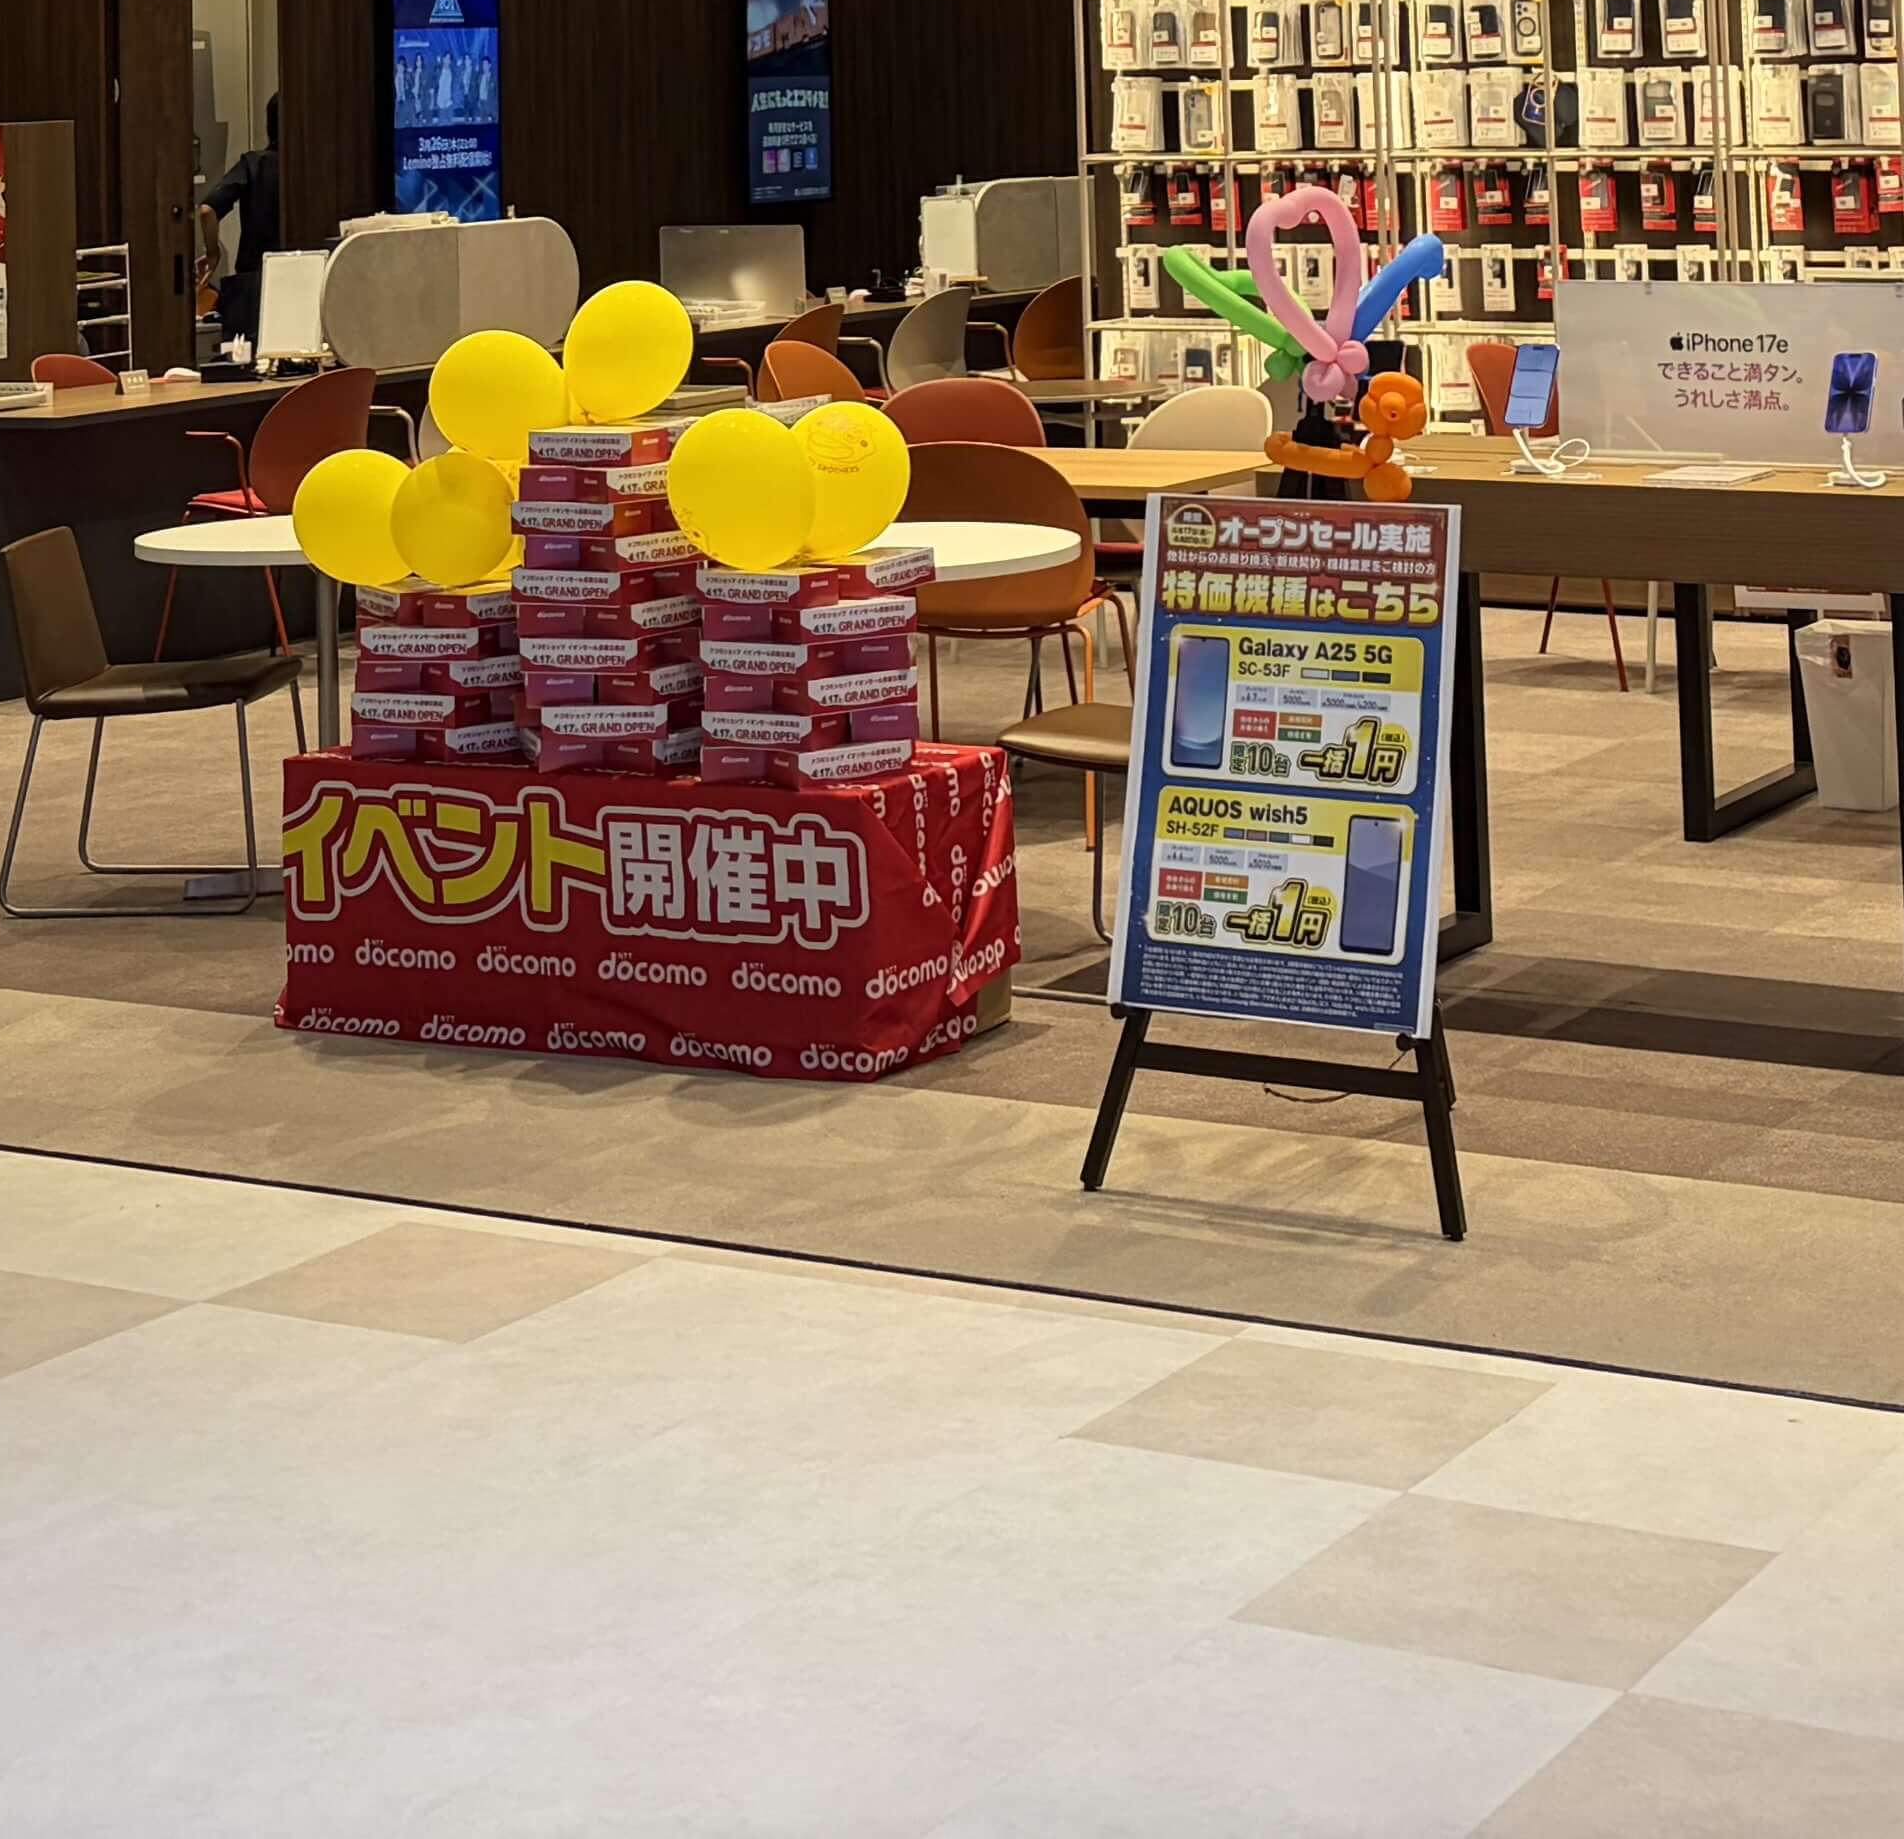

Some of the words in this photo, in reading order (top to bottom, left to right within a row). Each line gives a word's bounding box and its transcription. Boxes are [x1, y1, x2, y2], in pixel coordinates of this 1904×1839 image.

[1686, 333, 1753, 352] iPhone
[1756, 334, 1789, 353] 17e
[1657, 362, 1803, 384] できること満タン。
[1674, 388, 1790, 411] うれしさ満点。
[1219, 515, 1431, 553] オープンセール実施
[1162, 570, 1439, 623] 特価機種はこちら
[1239, 637, 1308, 660] Galaxy
[1315, 642, 1357, 661] A25
[1363, 645, 1392, 664] 5G
[1238, 661, 1290, 678] SC-53F
[1169, 796, 1242, 819] AQUOS
[1250, 805, 1308, 825] wish5
[1166, 820, 1219, 837] SH-52F
[283, 792, 858, 935] イベント開催中
[356, 938, 457, 971] docomo
[477, 945, 576, 977] docomo
[598, 952, 707, 988] docomo
[731, 962, 842, 998] docomo
[865, 955, 948, 1000] docomo
[420, 1014, 526, 1047] docomo
[546, 1022, 646, 1053] docomo
[799, 1044, 909, 1075] docomo
